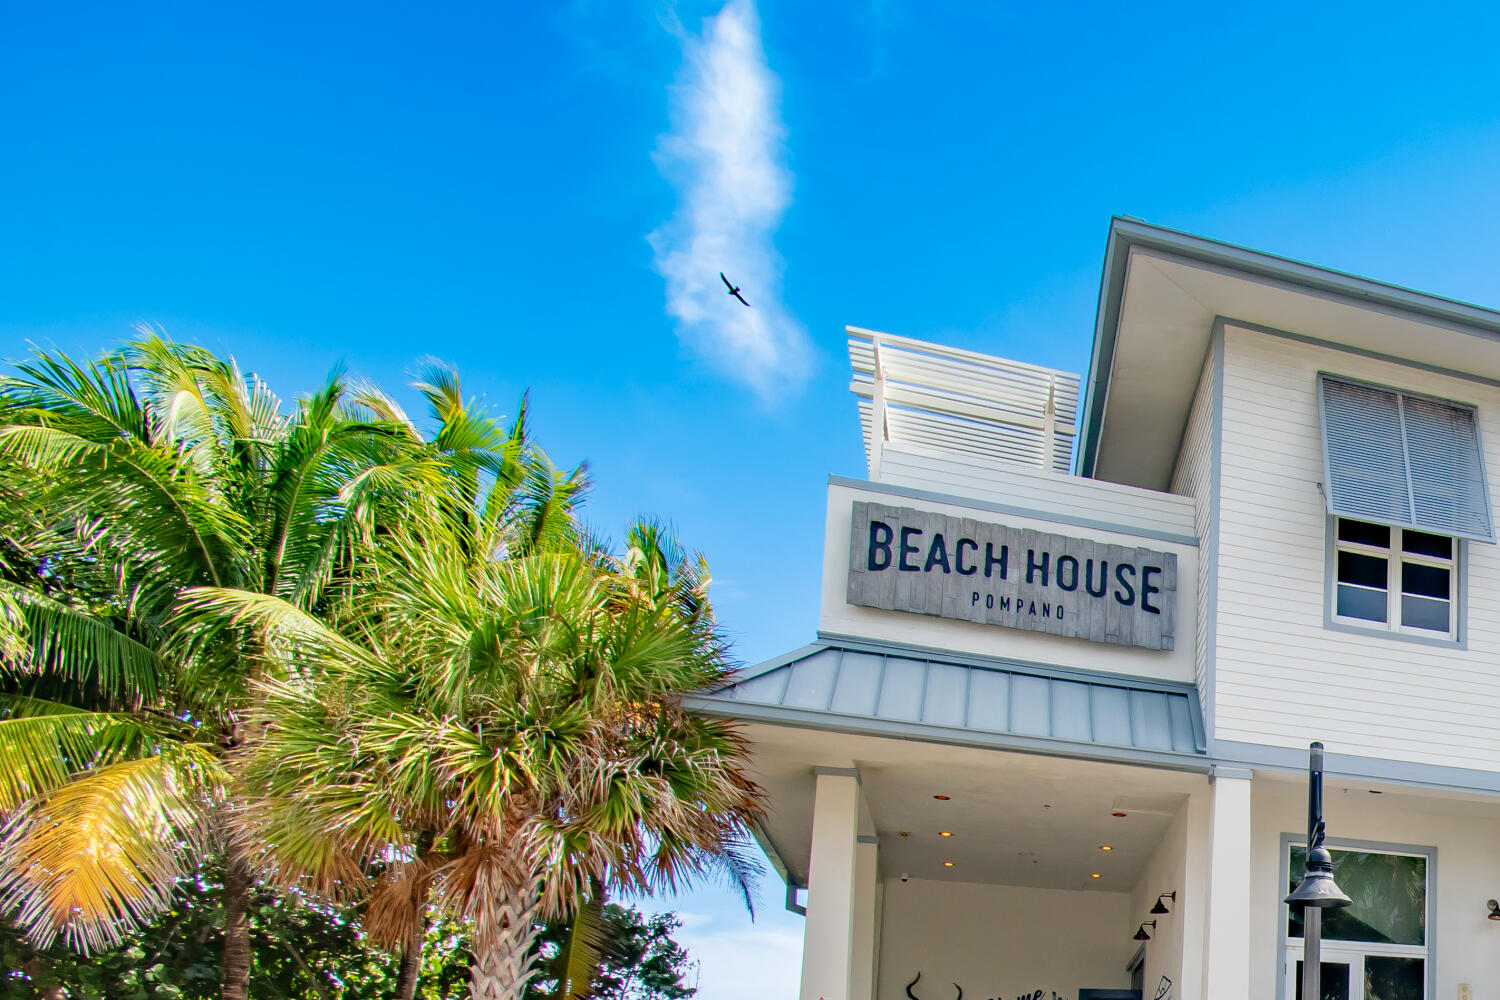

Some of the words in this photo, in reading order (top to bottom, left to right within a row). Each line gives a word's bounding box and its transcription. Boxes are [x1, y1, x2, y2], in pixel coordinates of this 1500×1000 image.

[867, 520, 1009, 580] BEACH
[1025, 548, 1162, 615] HOUSE
[971, 591, 1064, 620] POMPANO
